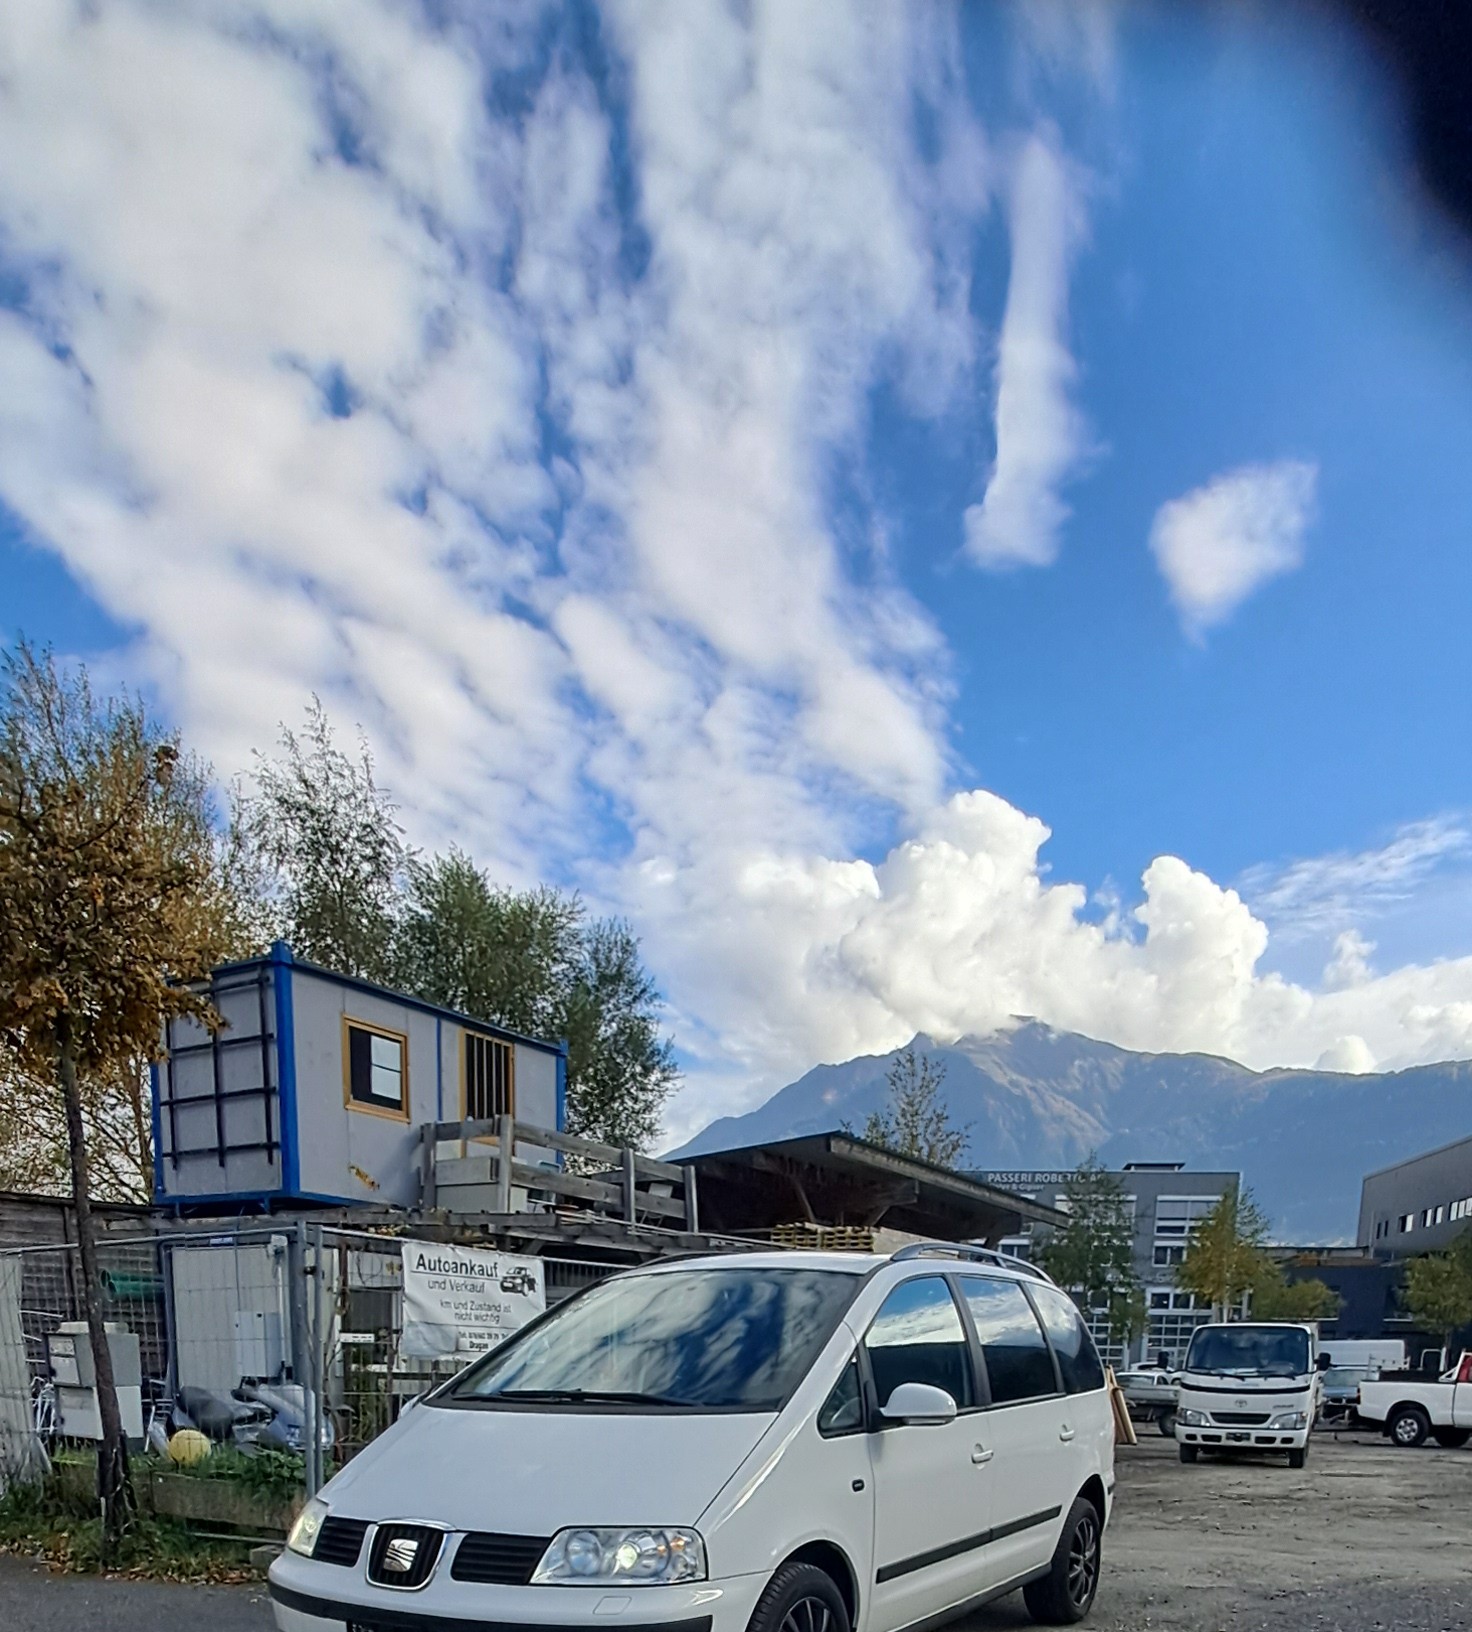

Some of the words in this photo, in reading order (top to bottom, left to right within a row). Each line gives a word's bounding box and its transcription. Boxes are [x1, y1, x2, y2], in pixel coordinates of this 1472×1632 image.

[988, 1173, 1032, 1183] PASSERI
[415, 1253, 498, 1277] Autoankauf
[427, 1279, 446, 1290] und
[448, 1279, 485, 1293] Verkauf
[453, 1301, 468, 1310] und
[469, 1300, 502, 1312] Zustand
